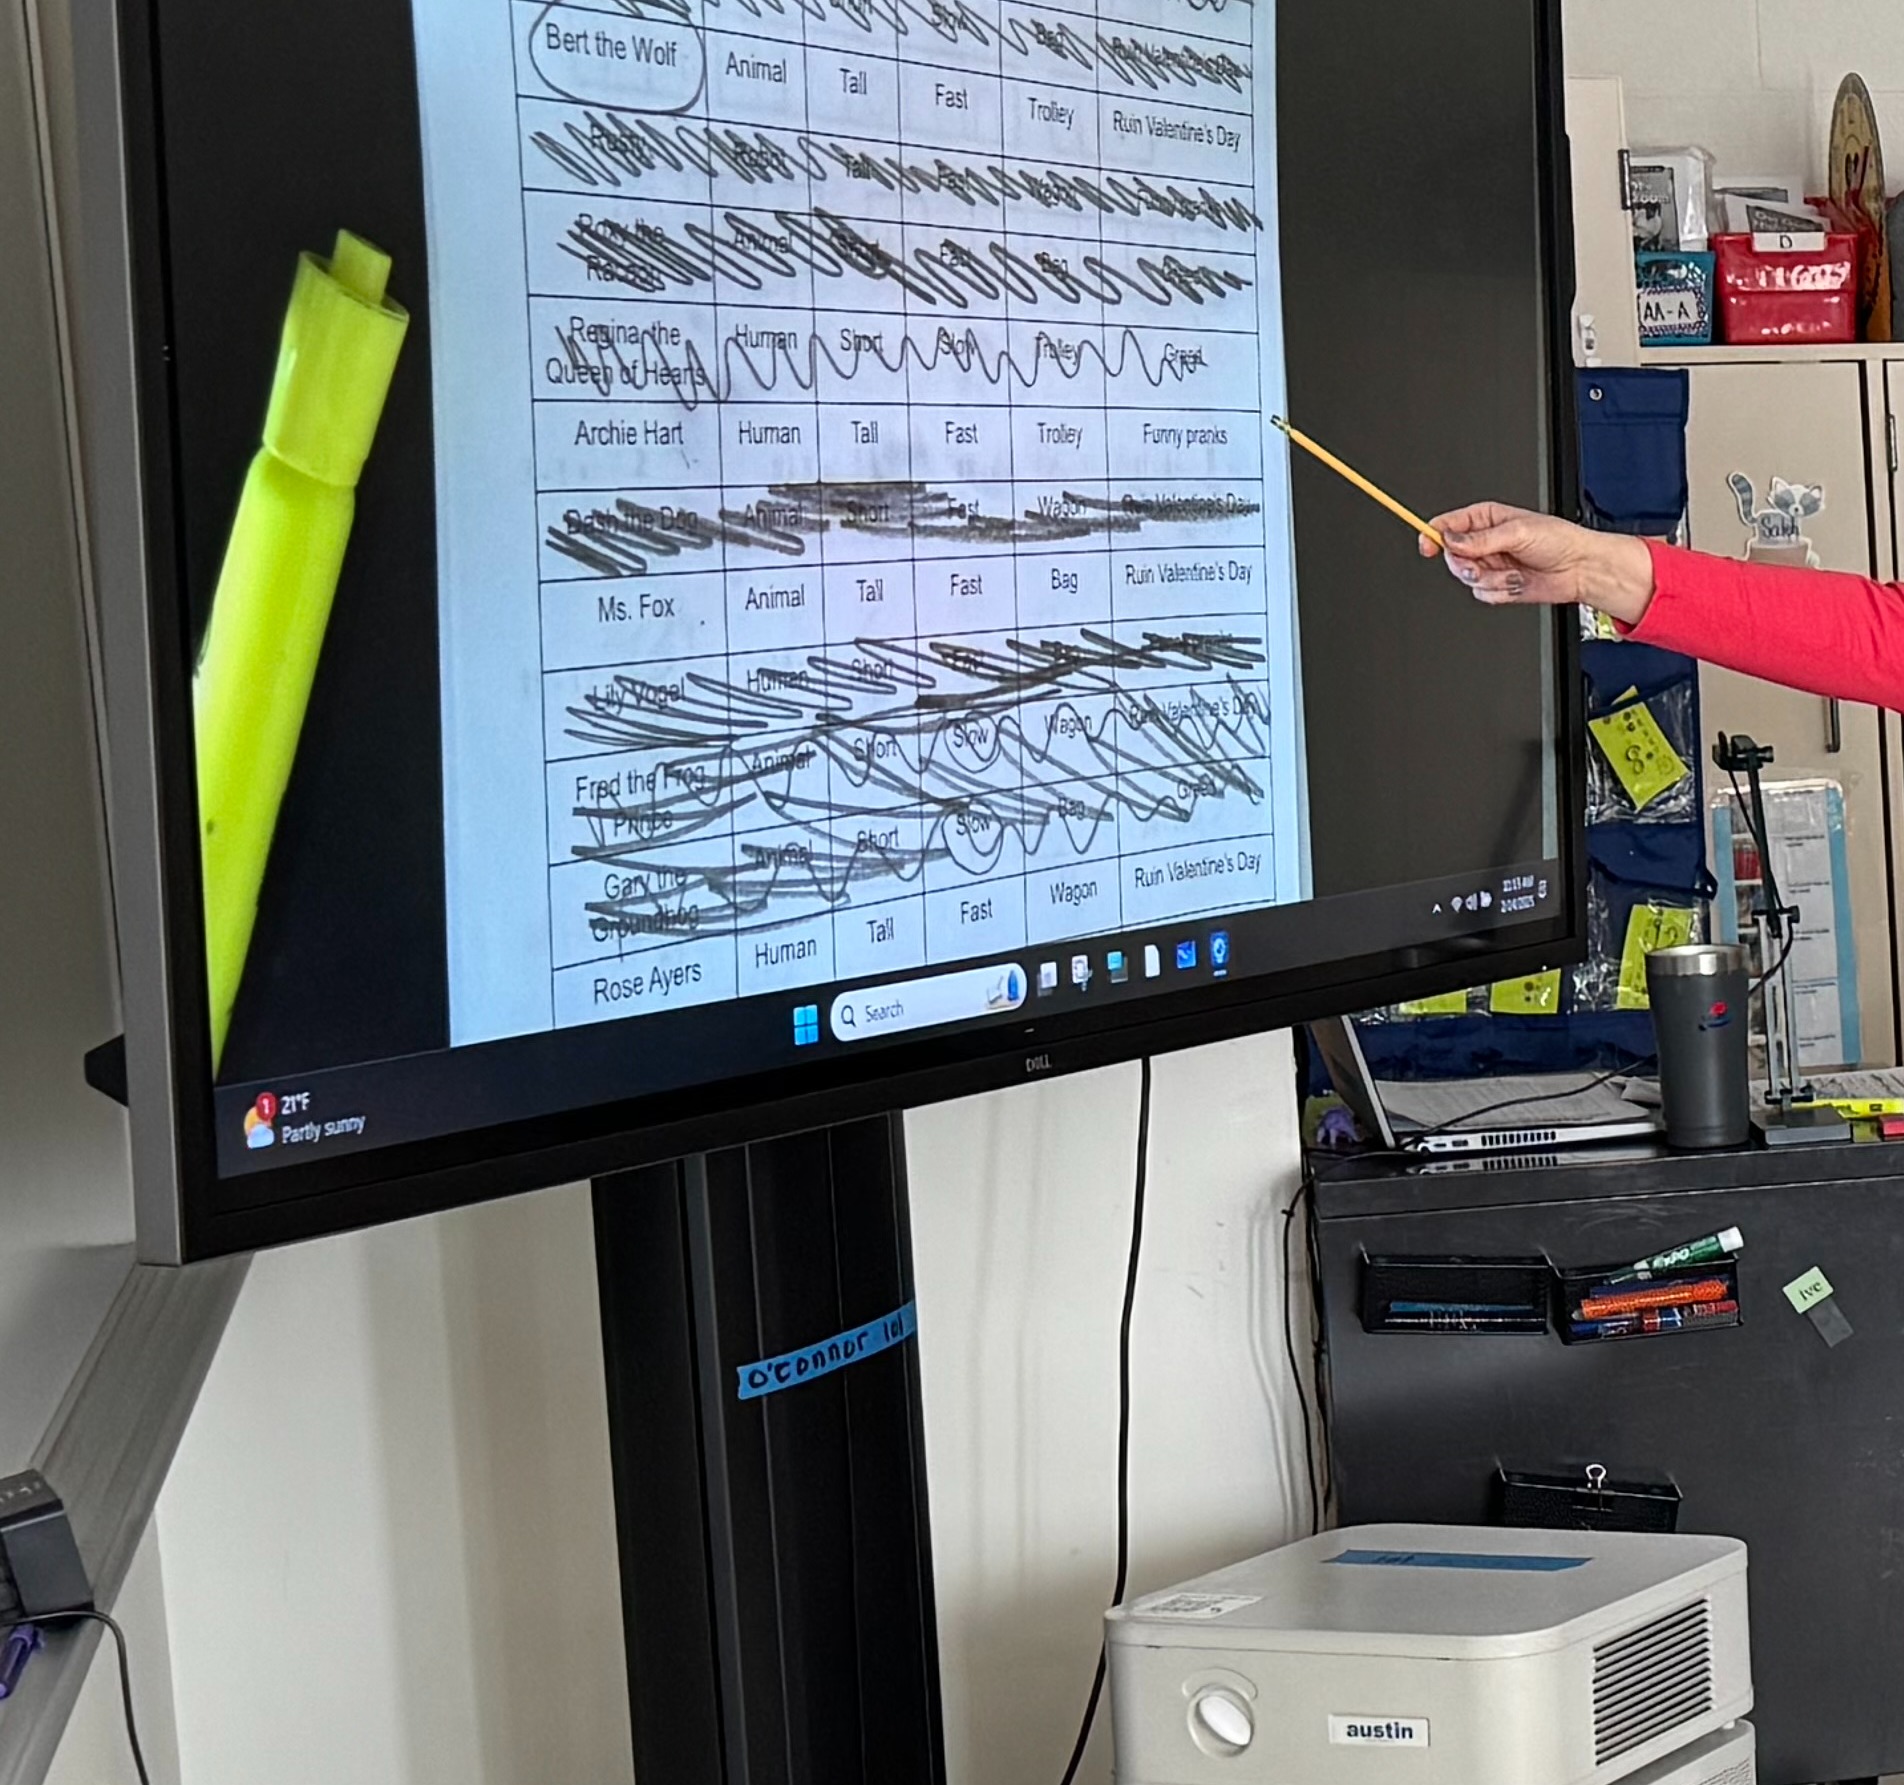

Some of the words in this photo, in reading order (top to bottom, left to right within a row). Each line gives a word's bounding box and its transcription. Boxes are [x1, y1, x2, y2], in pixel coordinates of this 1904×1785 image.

[546, 23, 590, 56] Bert
[595, 31, 628, 60] the
[632, 35, 677, 67] Wolf
[726, 52, 788, 84] Animal
[839, 68, 867, 96] Tall
[935, 83, 968, 110] Fast
[1028, 97, 1075, 130] Trolley
[1113, 110, 1143, 136] Ruin
[1146, 115, 1214, 145] Valentine's
[1217, 126, 1241, 153] Day
[1779, 234, 1793, 250] D
[651, 321, 681, 346] the
[735, 323, 798, 351] Human
[574, 420, 638, 447] Archie
[644, 419, 684, 446] Hart
[738, 420, 802, 446] Human
[851, 420, 879, 445] Tall
[945, 421, 979, 445] Fast
[1037, 421, 1083, 450] Trolley
[1143, 423, 1183, 448] Funny
[1186, 424, 1229, 448] pranks
[950, 572, 983, 596] Fast
[1052, 568, 1078, 593] Bag
[1126, 565, 1155, 585] Ruin
[1157, 561, 1225, 585] Valentine's
[1229, 563, 1252, 586] Day
[745, 584, 806, 611] Animal
[856, 578, 884, 603] Tall
[598, 597, 632, 623] Ms.
[640, 593, 675, 618] Fox
[1044, 713, 1092, 739] Wagon
[627, 770, 655, 794] the
[1135, 865, 1164, 889] Ruin
[1166, 854, 1236, 882] Valentine's
[1237, 851, 1261, 874] Day
[1050, 878, 1098, 906] Wagon
[960, 899, 993, 925] Fast
[866, 917, 894, 943] Tall
[755, 938, 817, 968] Human
[593, 977, 645, 1005] Rose
[649, 962, 702, 996] Ayers
[865, 1000, 904, 1023] Search
[281, 1120, 321, 1145] Partly
[324, 1114, 366, 1137] sunny
[1346, 1720, 1414, 1740] austin
